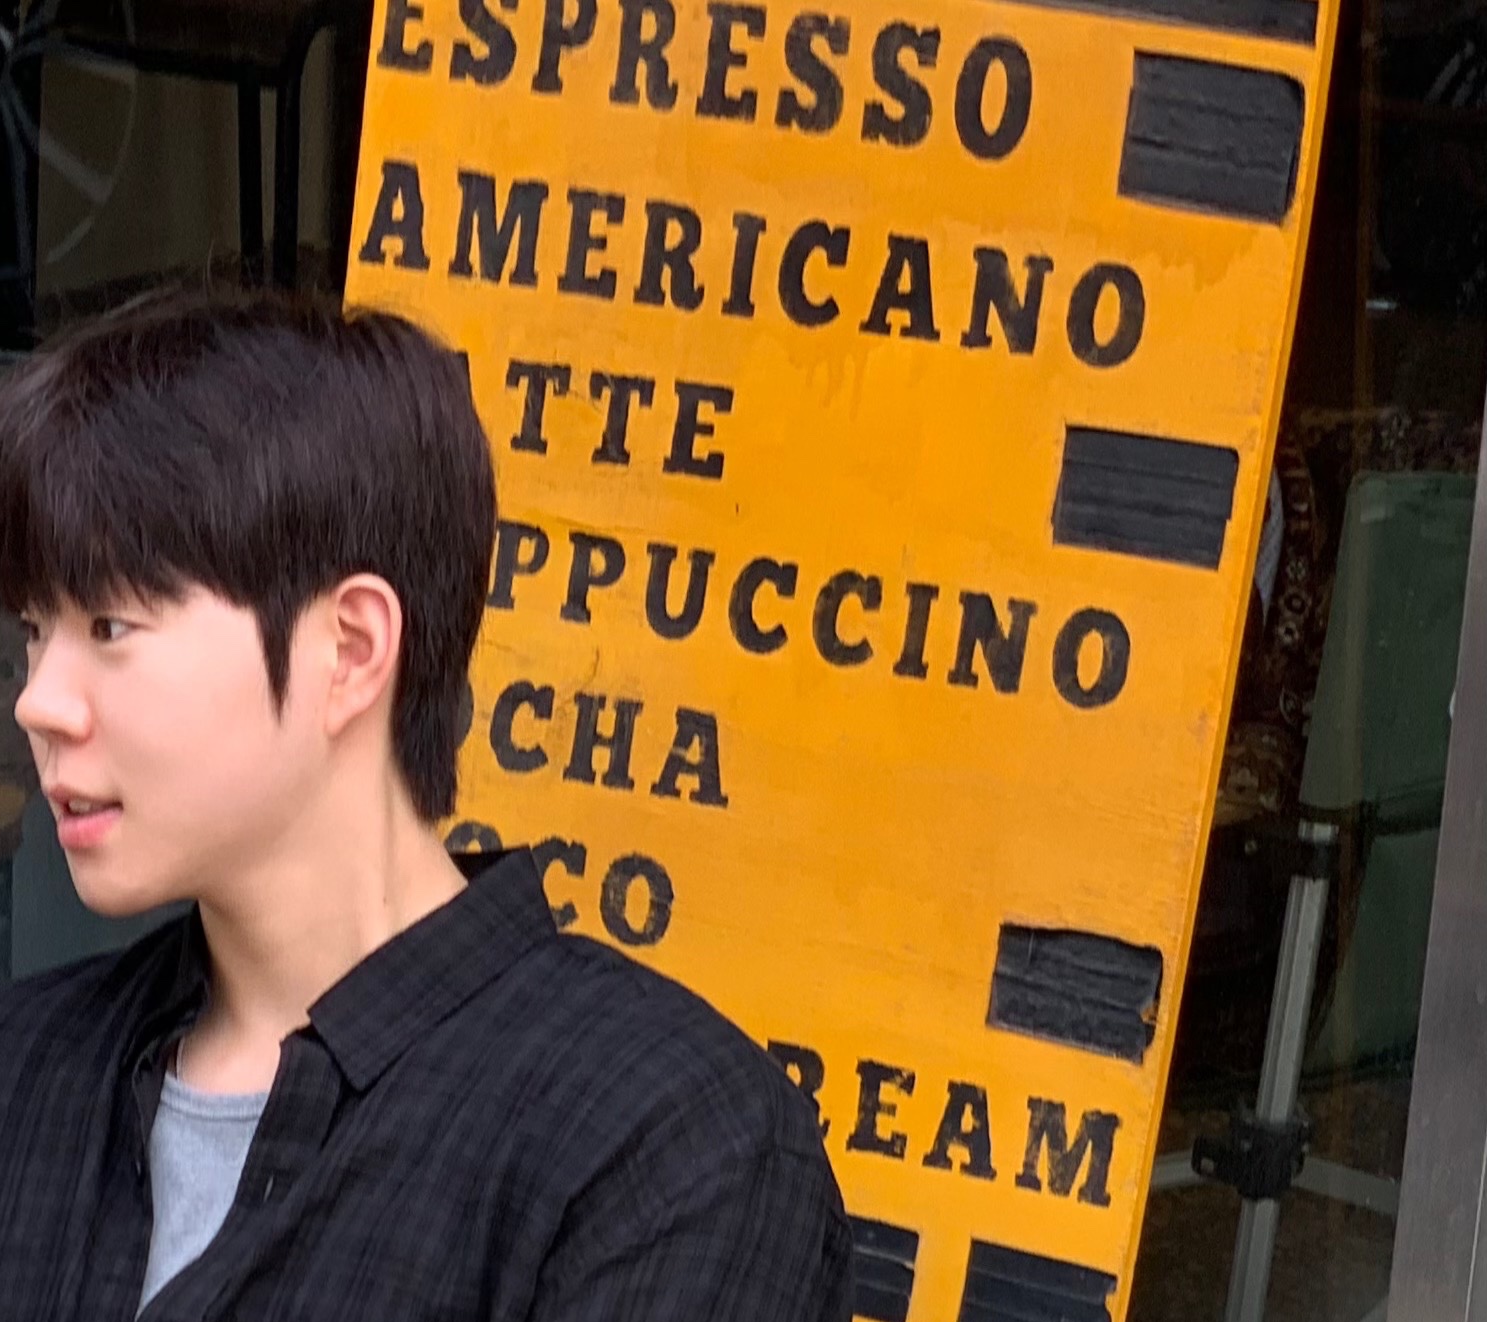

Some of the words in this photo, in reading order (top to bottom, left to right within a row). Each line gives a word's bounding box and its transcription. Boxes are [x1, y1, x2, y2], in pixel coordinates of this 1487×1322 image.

[379, 0, 1031, 159] ESPRESSO
[359, 162, 1145, 367] AMERICANO
[504, 358, 734, 481] TTE
[457, 680, 728, 808] CHA
